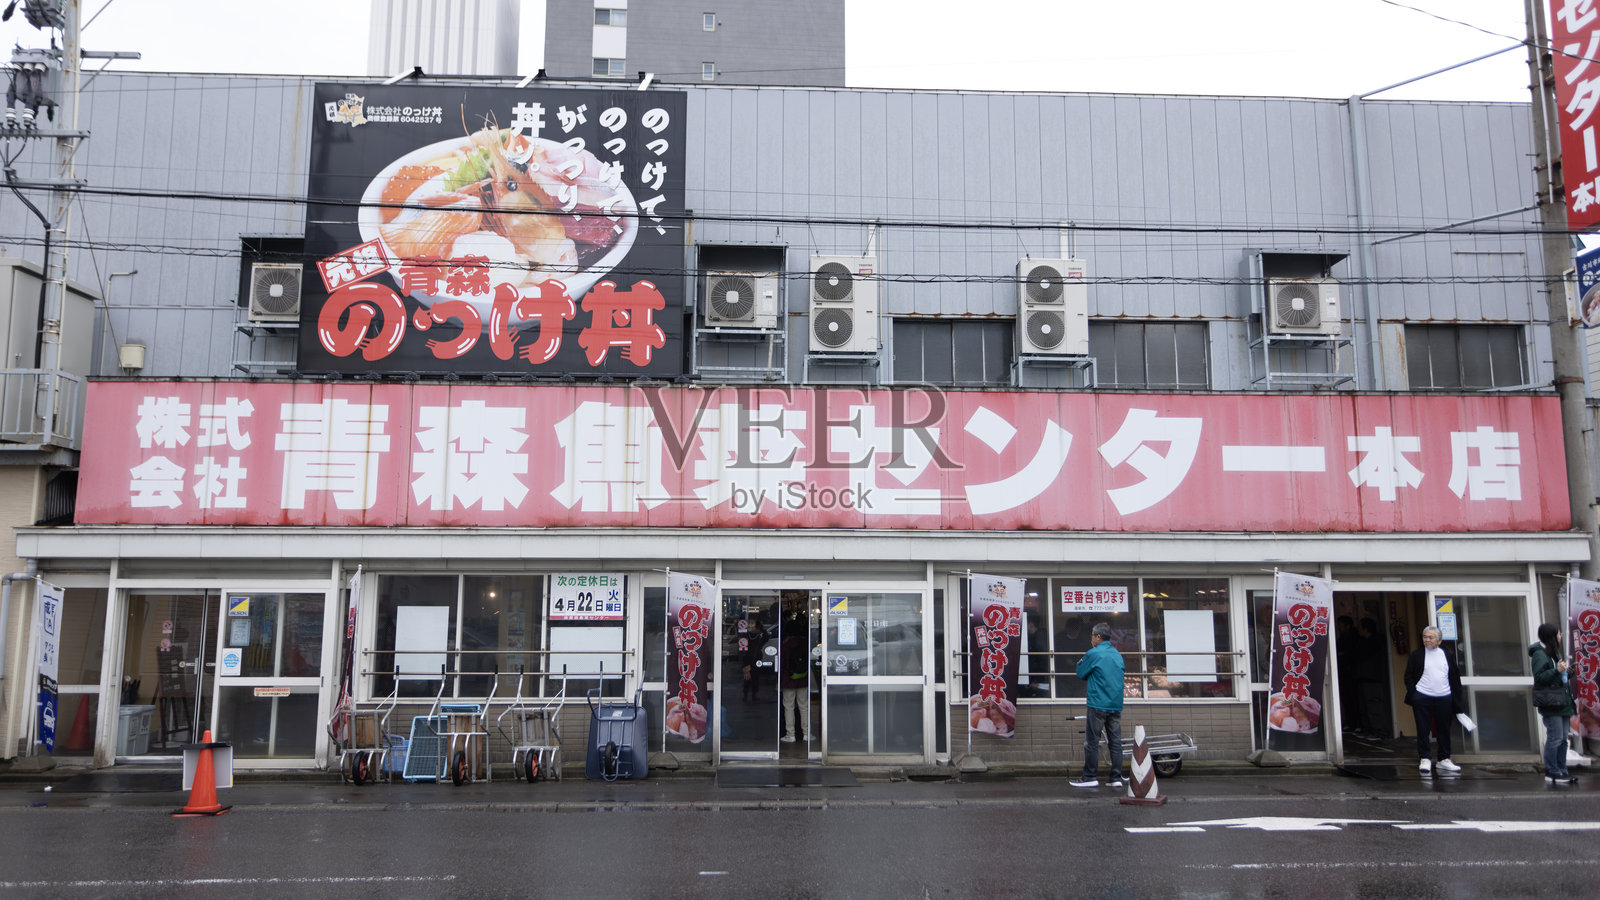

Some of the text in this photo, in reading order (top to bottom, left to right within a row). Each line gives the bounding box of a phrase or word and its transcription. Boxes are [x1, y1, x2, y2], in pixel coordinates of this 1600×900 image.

[556, 103, 588, 222] がっつり、
[596, 107, 628, 235] のっけて、
[639, 108, 670, 235] のっけて、
[1571, 175, 1600, 213] 本
[325, 245, 386, 288] 元祖
[399, 254, 491, 297] 青森
[317, 279, 666, 366] のっけ丼
[136, 394, 256, 450] 株式
[129, 455, 249, 510] 会社
[557, 575, 618, 587] 次の定休日は
[1063, 590, 1126, 604] 空番台有ります
[1007, 606, 1020, 637] 青森
[1314, 606, 1328, 636] 青森
[678, 603, 702, 709] のっけ丼
[979, 603, 1010, 704] のっけ丼
[1281, 602, 1317, 701] のっけ丼
